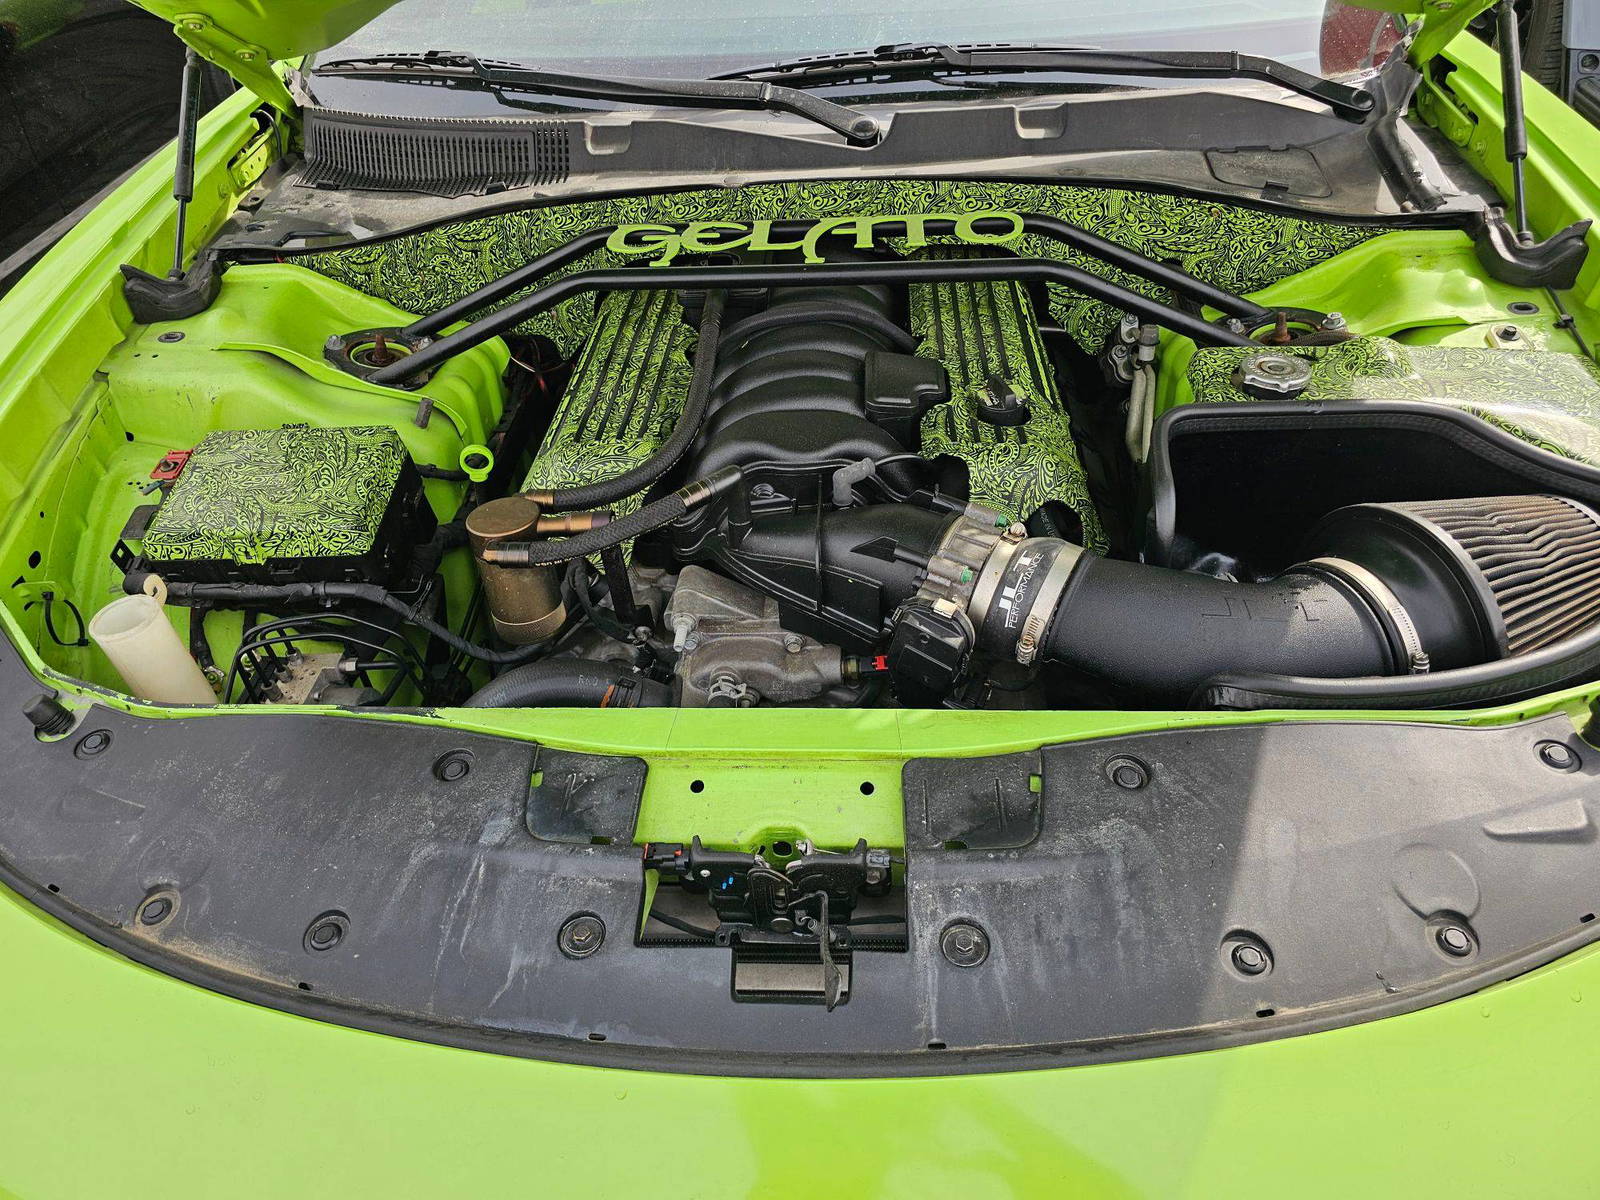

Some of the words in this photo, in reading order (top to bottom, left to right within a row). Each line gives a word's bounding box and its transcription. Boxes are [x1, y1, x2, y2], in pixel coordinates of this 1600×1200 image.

[607, 211, 1024, 267] GELATO
[999, 550, 1032, 628] JLT
[1008, 553, 1044, 629] PERFORMANCE
